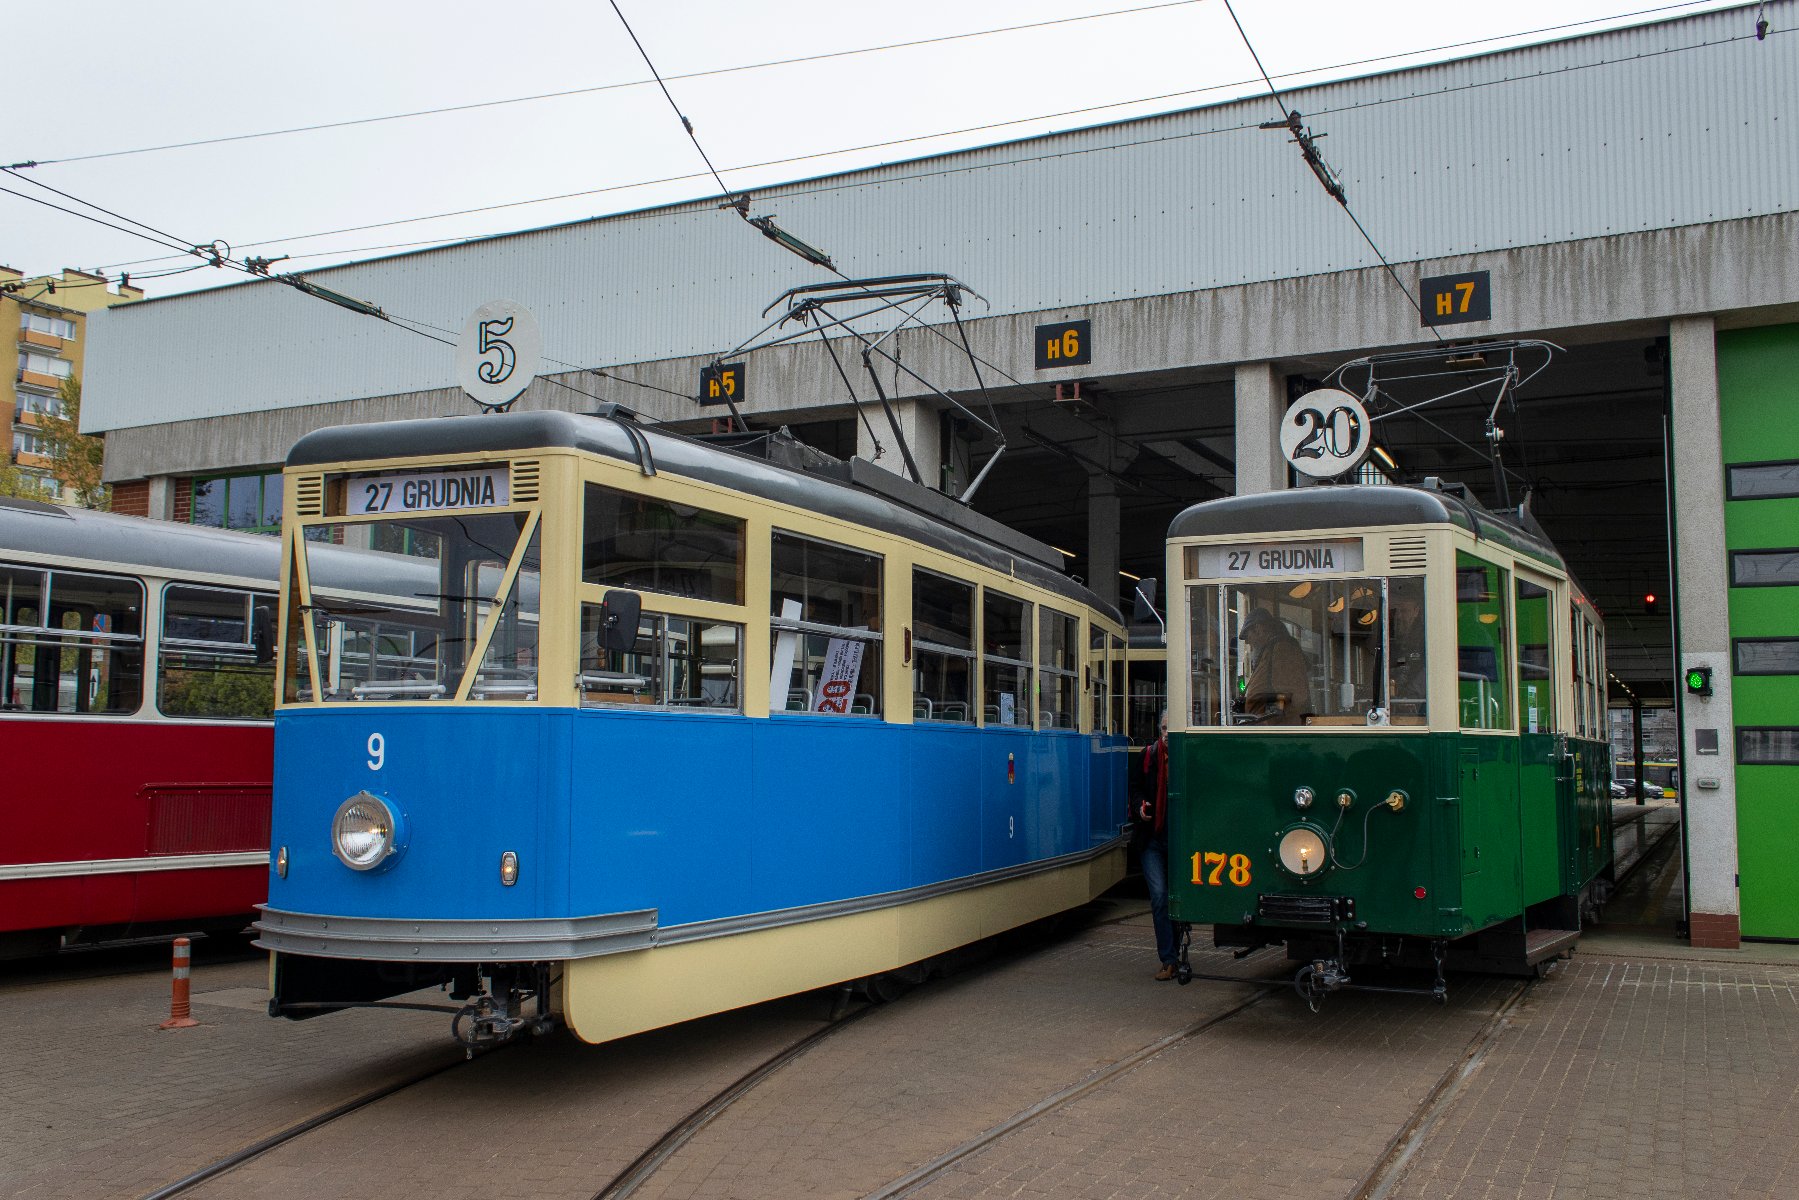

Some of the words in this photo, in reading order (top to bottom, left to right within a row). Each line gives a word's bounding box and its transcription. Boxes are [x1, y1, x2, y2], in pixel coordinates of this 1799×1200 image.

[1436, 282, 1475, 316] H7
[478, 317, 516, 383] 5
[1047, 331, 1079, 360] H6
[1294, 406, 1360, 459] 20
[365, 484, 391, 511] 27
[403, 476, 495, 508] GRUDNIA
[1229, 553, 1250, 572] 27
[1259, 550, 1334, 570] GRUDNIA
[367, 733, 384, 770] 9
[1009, 816, 1014, 839] 9
[1190, 851, 1252, 887] 178
